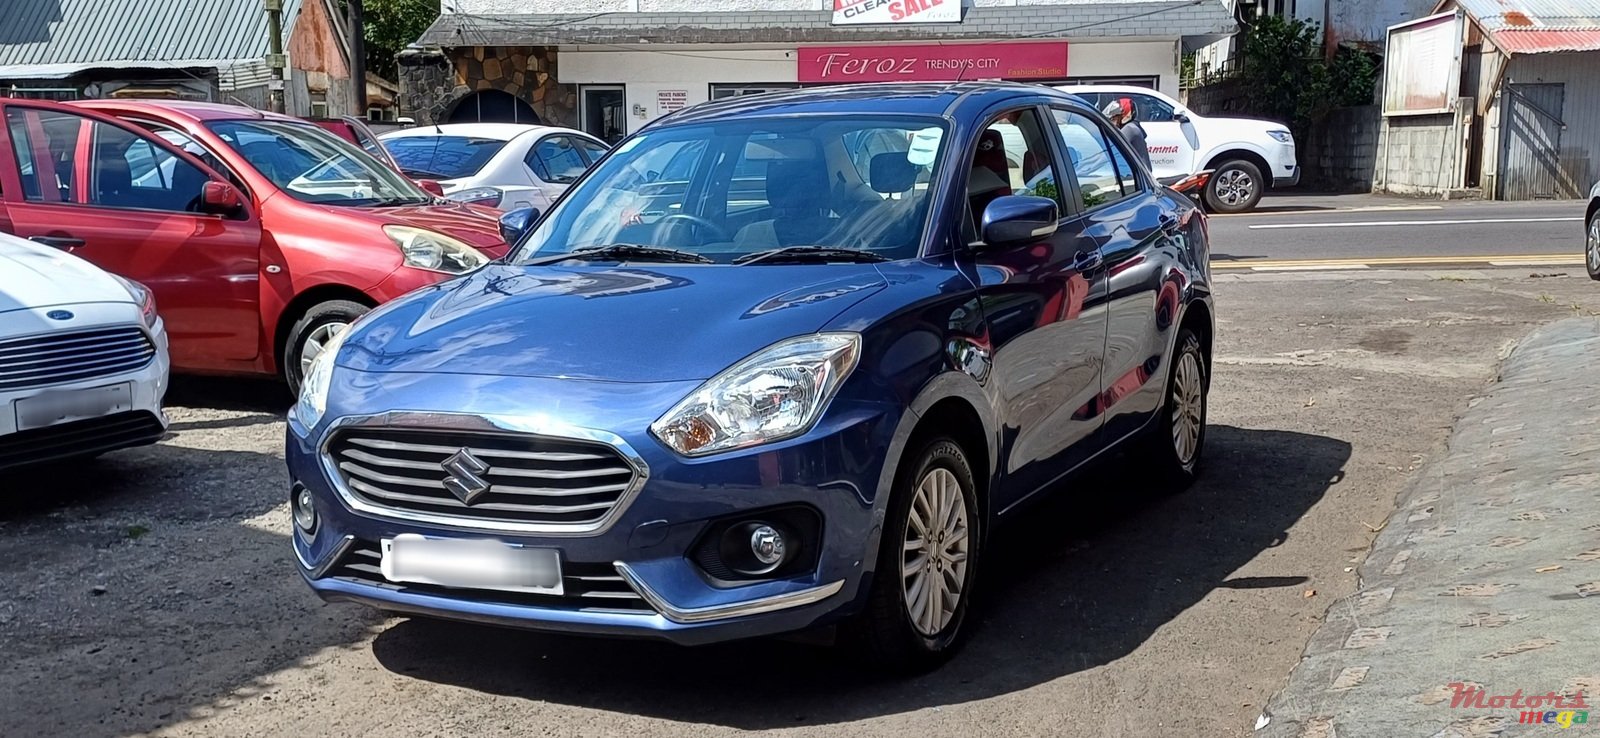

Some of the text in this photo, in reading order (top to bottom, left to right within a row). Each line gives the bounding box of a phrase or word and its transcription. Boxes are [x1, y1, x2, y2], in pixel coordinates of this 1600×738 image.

[843, 0, 891, 18] CLEA
[816, 53, 1000, 77] Feroz TRENDY'S CITY
[1007, 67, 1062, 76] Fashion Studio
[1146, 145, 1179, 154] amma
